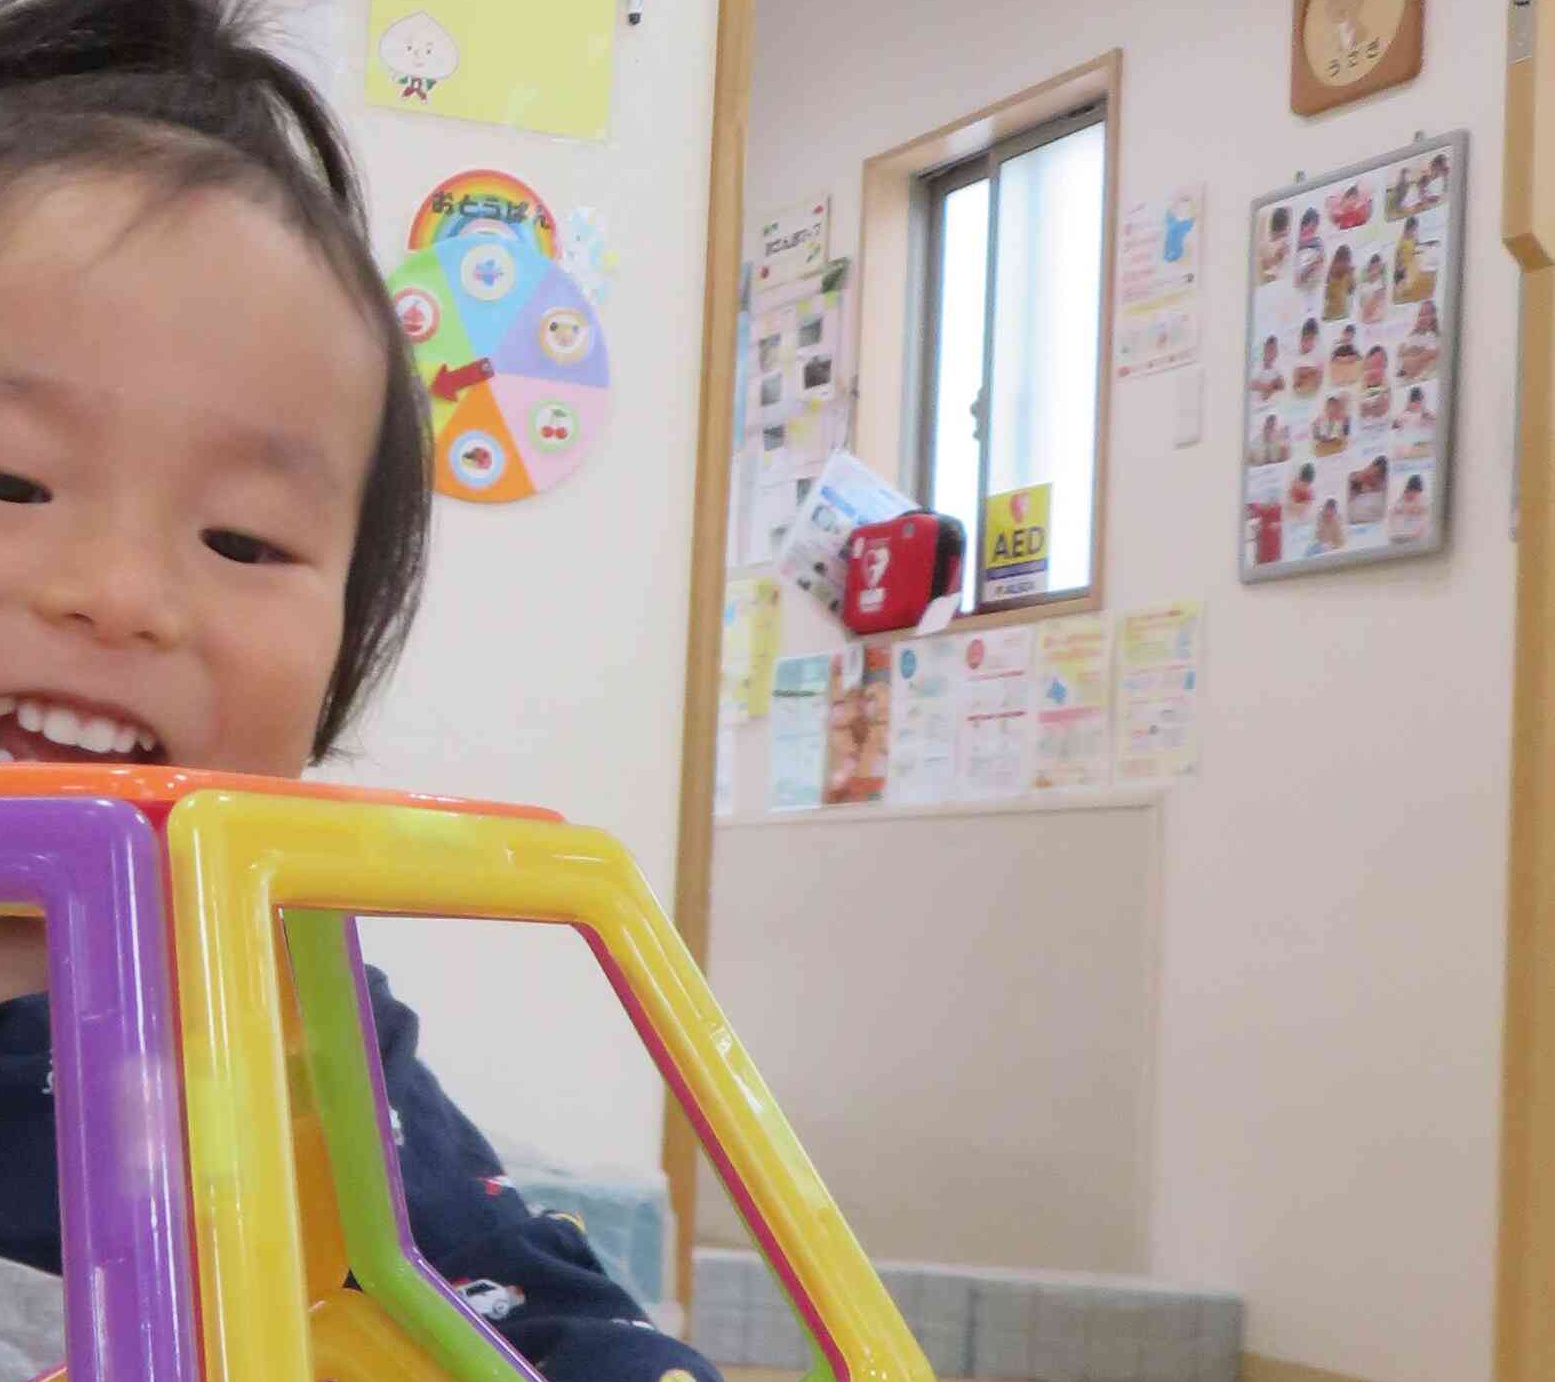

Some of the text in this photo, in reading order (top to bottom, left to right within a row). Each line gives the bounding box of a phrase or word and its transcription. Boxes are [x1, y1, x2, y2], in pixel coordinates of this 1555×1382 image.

[431, 190, 553, 231] おとうばん
[992, 526, 1044, 562] AED
